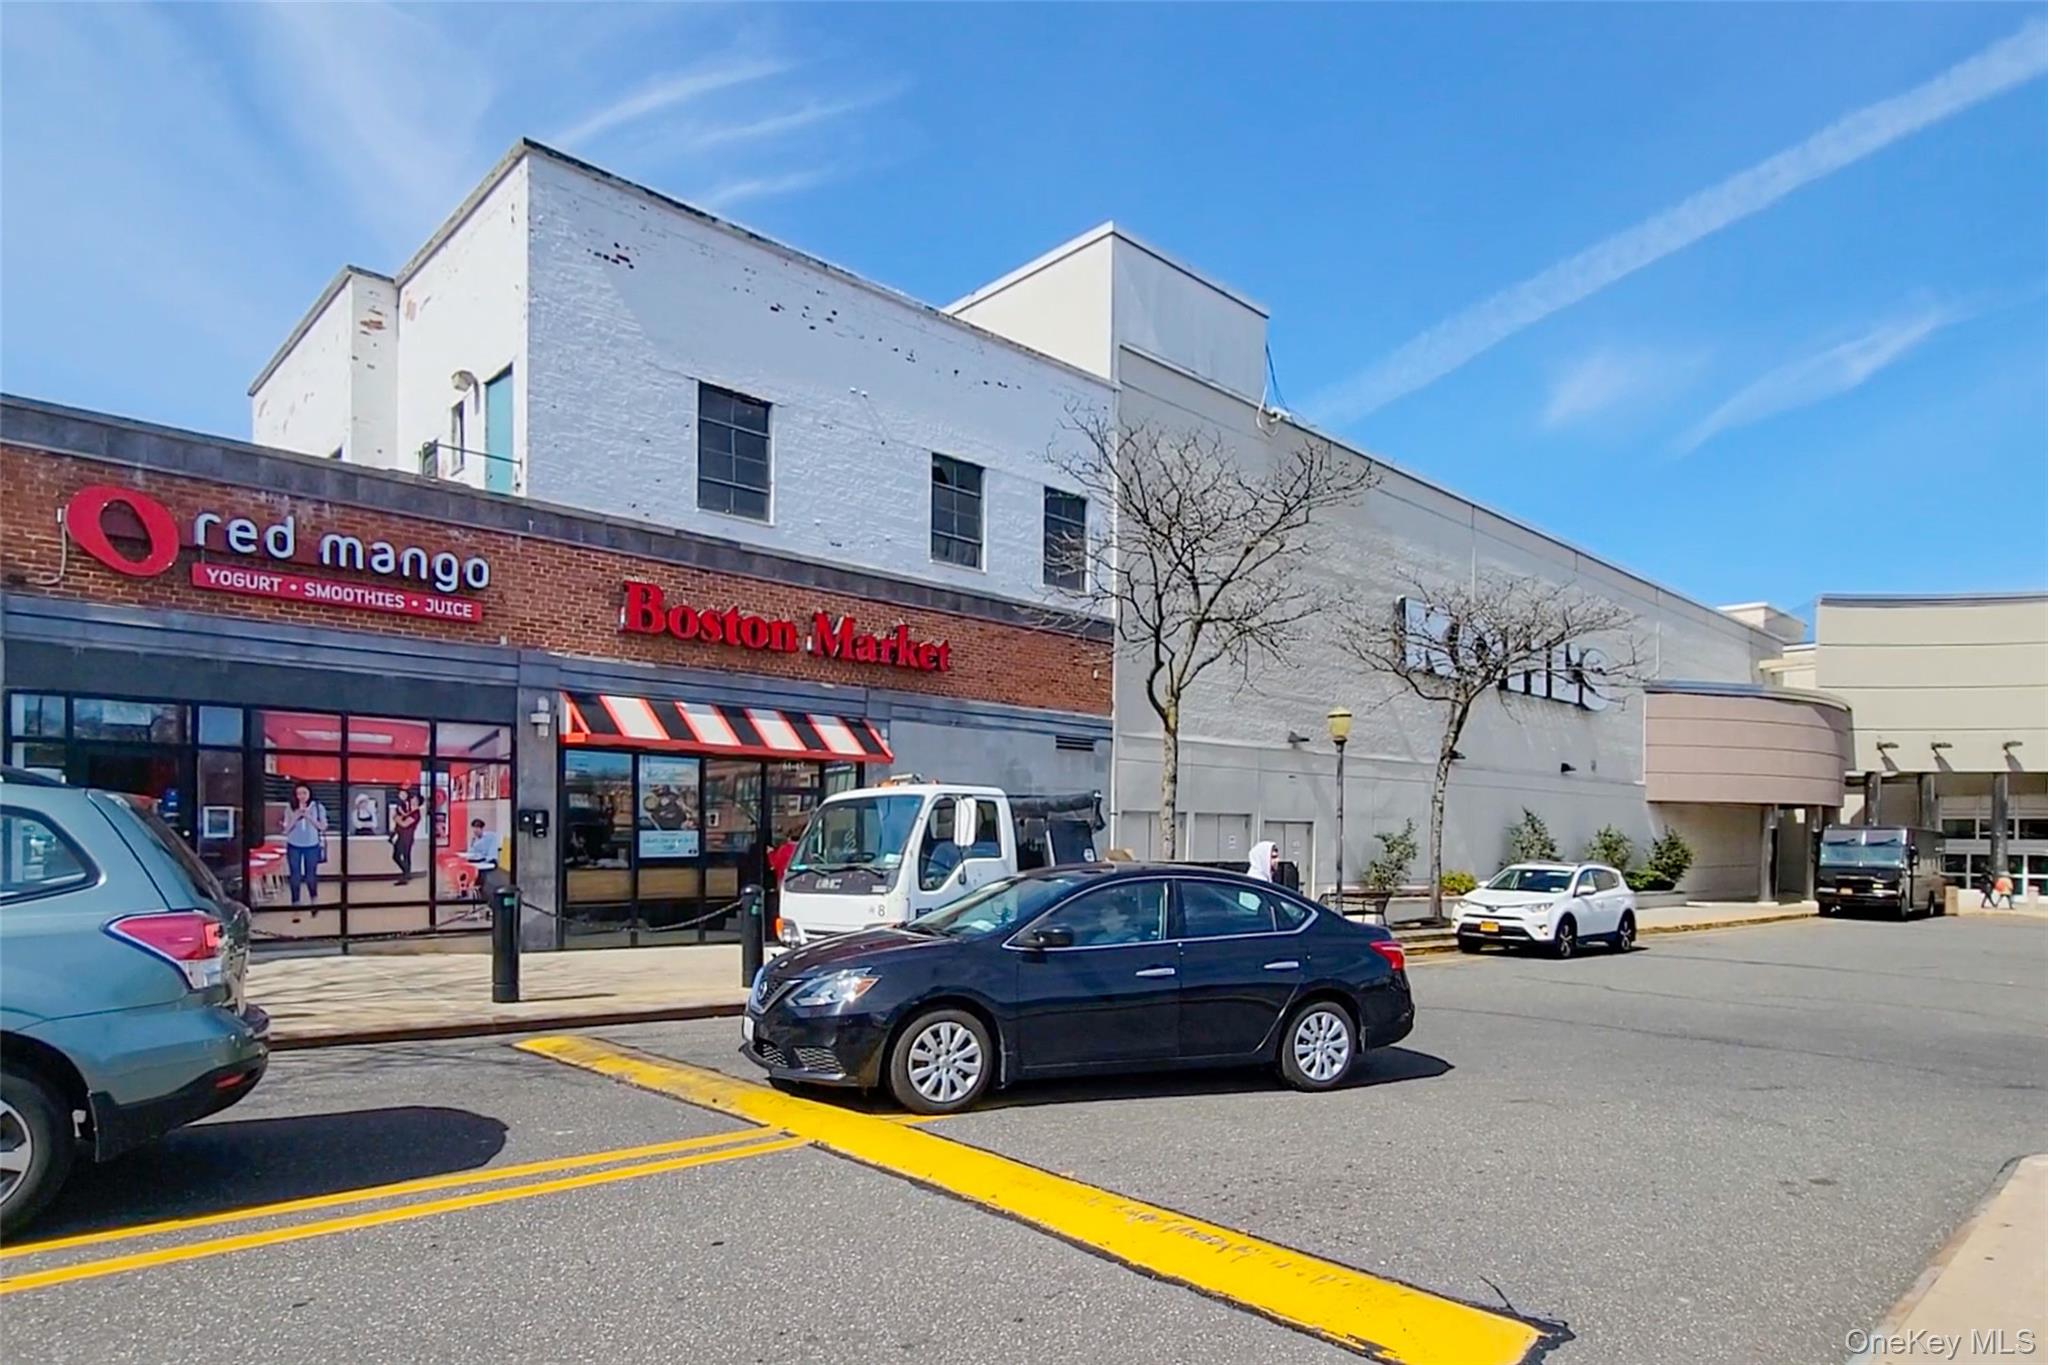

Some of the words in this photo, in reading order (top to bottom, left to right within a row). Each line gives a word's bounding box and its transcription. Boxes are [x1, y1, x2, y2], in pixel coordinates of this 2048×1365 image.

[193, 511, 296, 560] red
[320, 532, 490, 593] mango
[206, 567, 283, 593] YOGURT
[304, 582, 406, 610] SMOOTHIES
[425, 597, 473, 618] JUICE
[622, 579, 799, 654] Boston
[811, 609, 952, 673] Market
